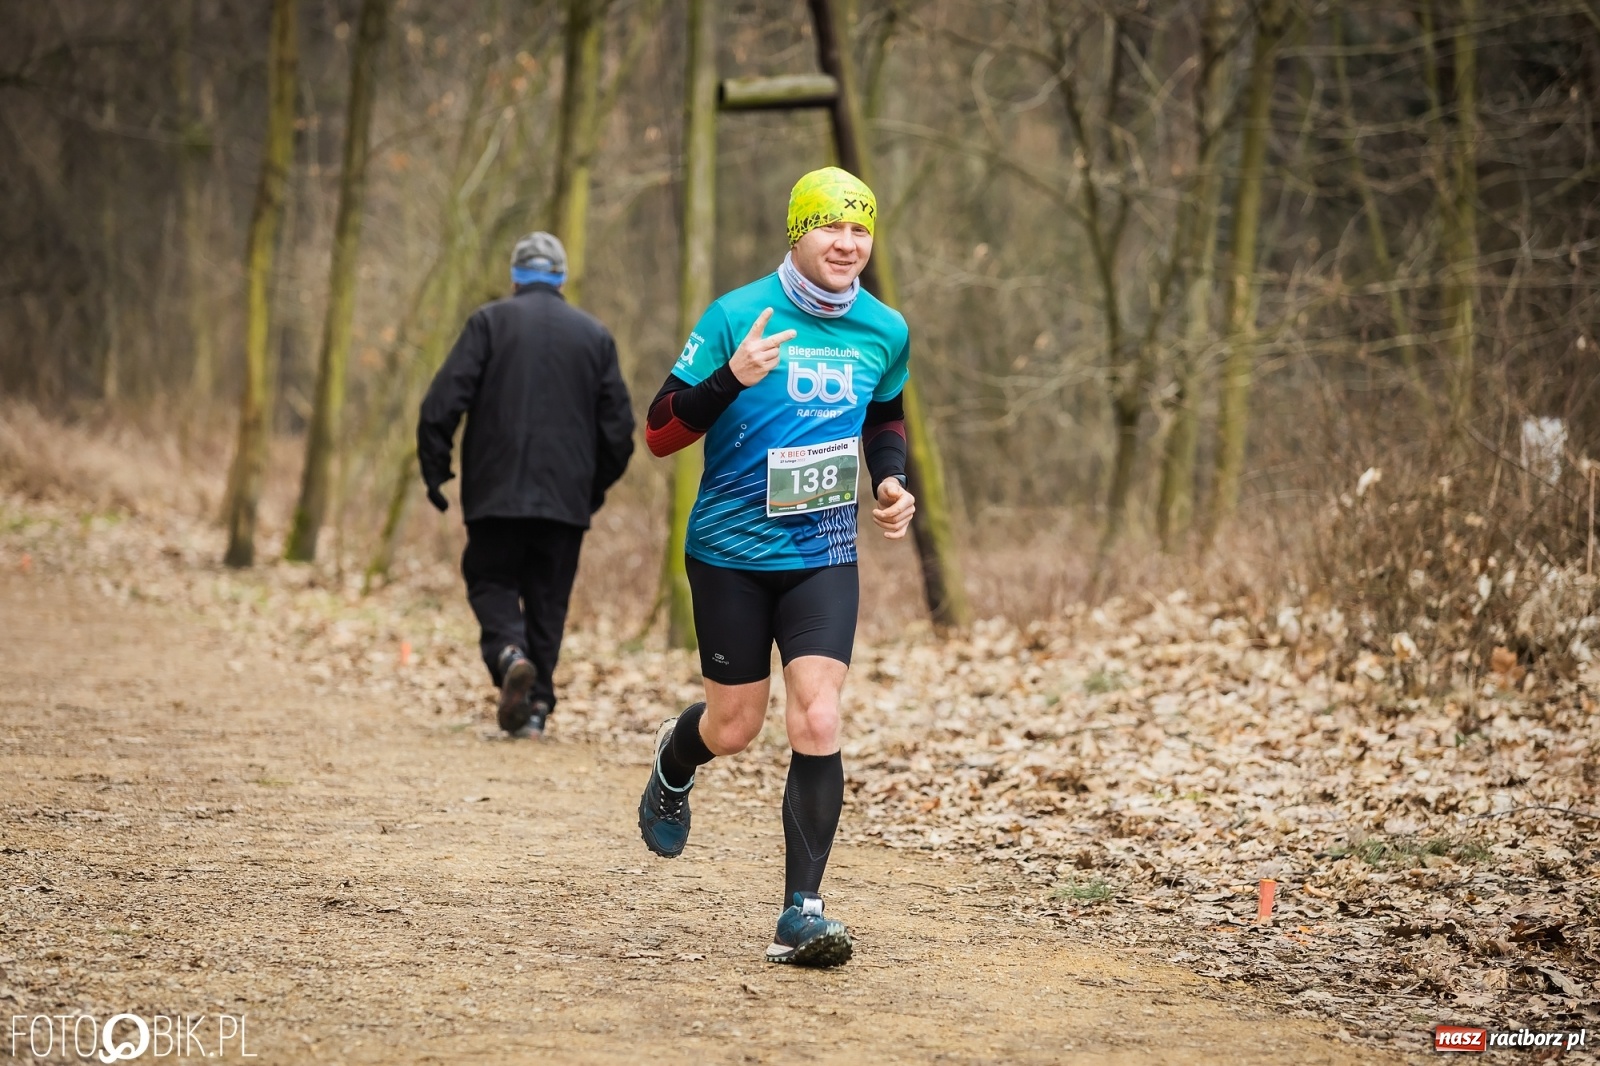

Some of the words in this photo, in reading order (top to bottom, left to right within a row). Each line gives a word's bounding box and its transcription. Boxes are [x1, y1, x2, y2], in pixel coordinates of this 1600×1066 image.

[788, 345, 860, 360] BiegamBoLubię
[787, 361, 858, 405] bbl
[780, 451, 786, 459] X
[787, 450, 806, 458] BIEG
[807, 442, 849, 456] Twardziela
[791, 465, 838, 495] 138
